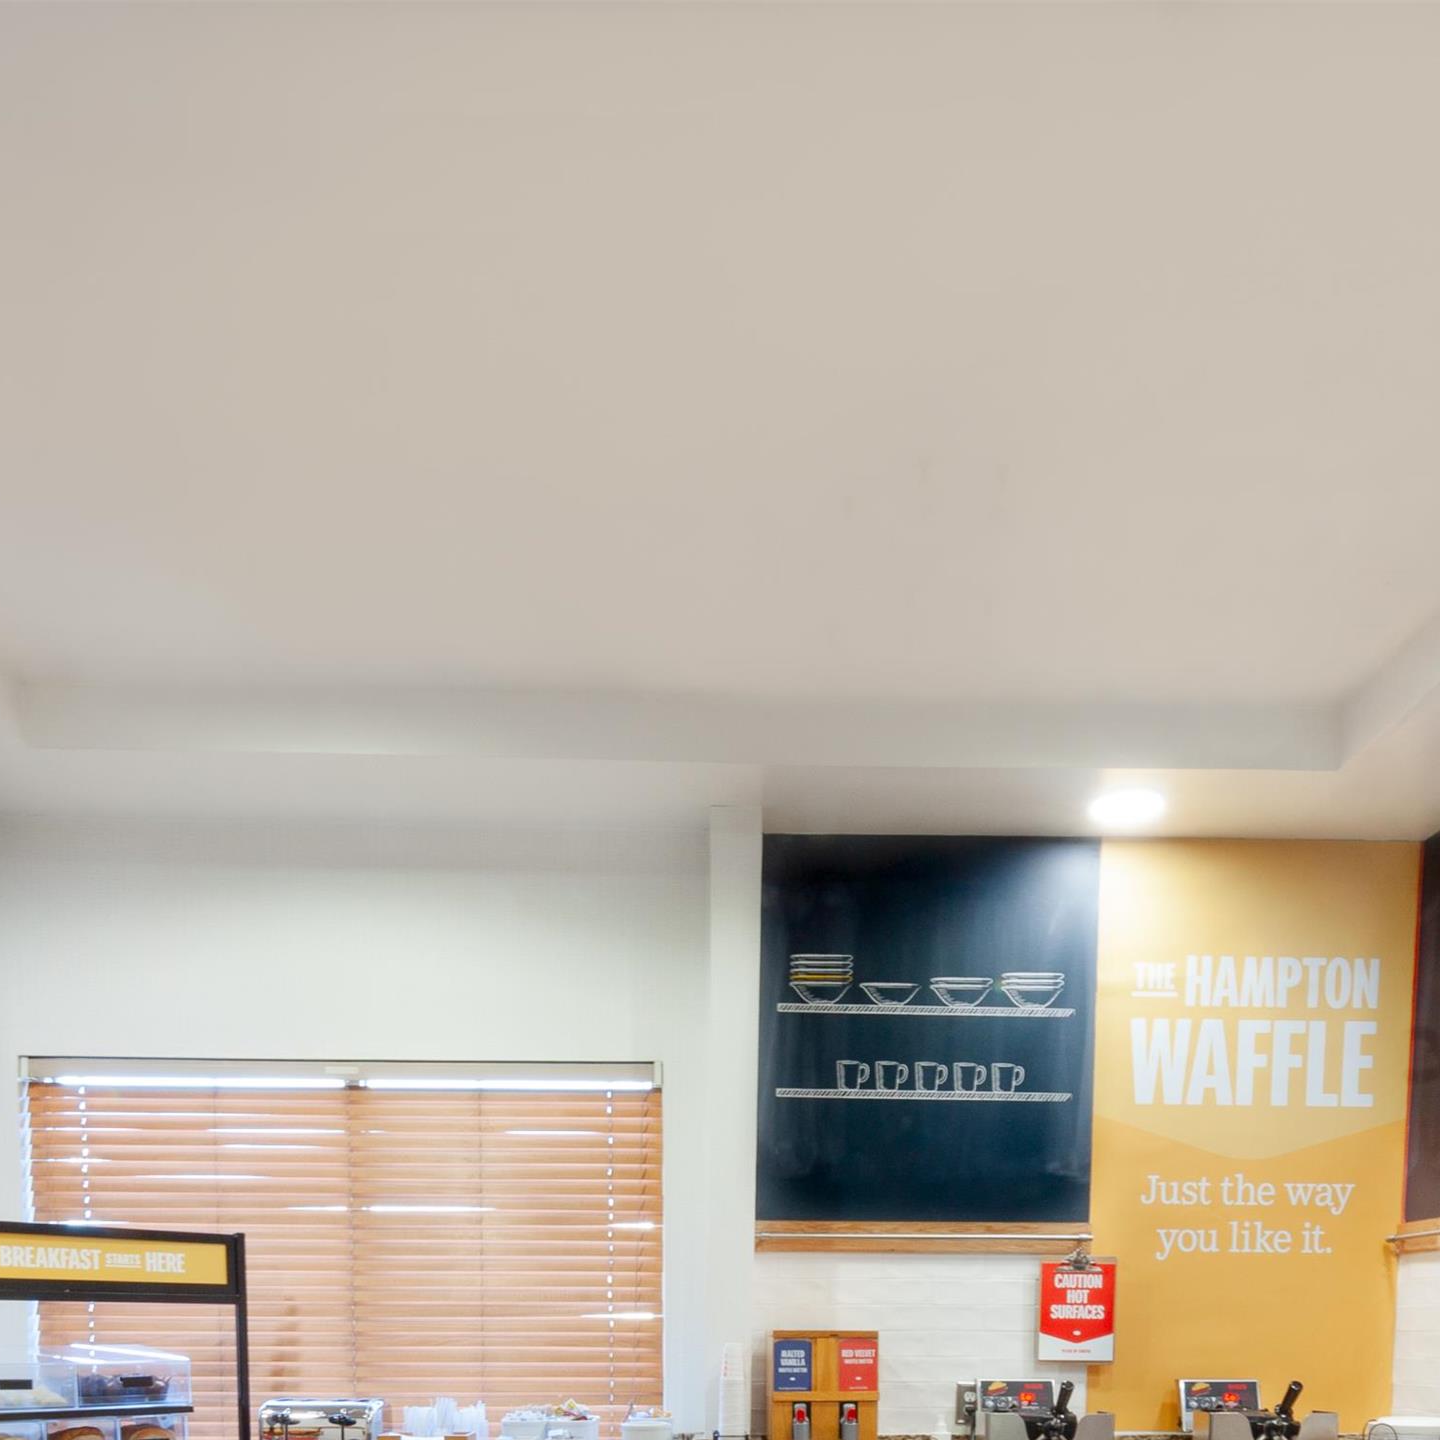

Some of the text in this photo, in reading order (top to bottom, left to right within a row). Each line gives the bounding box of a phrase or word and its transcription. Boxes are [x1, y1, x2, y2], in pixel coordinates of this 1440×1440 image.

[1132, 955, 1381, 1009] THE HAMPTON
[1130, 1017, 1377, 1107] WAFFLE
[1140, 1173, 1355, 1215] Just the way
[1155, 1221, 1333, 1260] you like it.
[0, 1245, 102, 1270] BREAKFAST
[105, 1253, 141, 1266] STARTS
[145, 1251, 186, 1273] HERE
[1054, 1273, 1103, 1288] CAUTION
[1066, 1289, 1090, 1304] HOT
[1050, 1304, 1105, 1319] SURFACES
